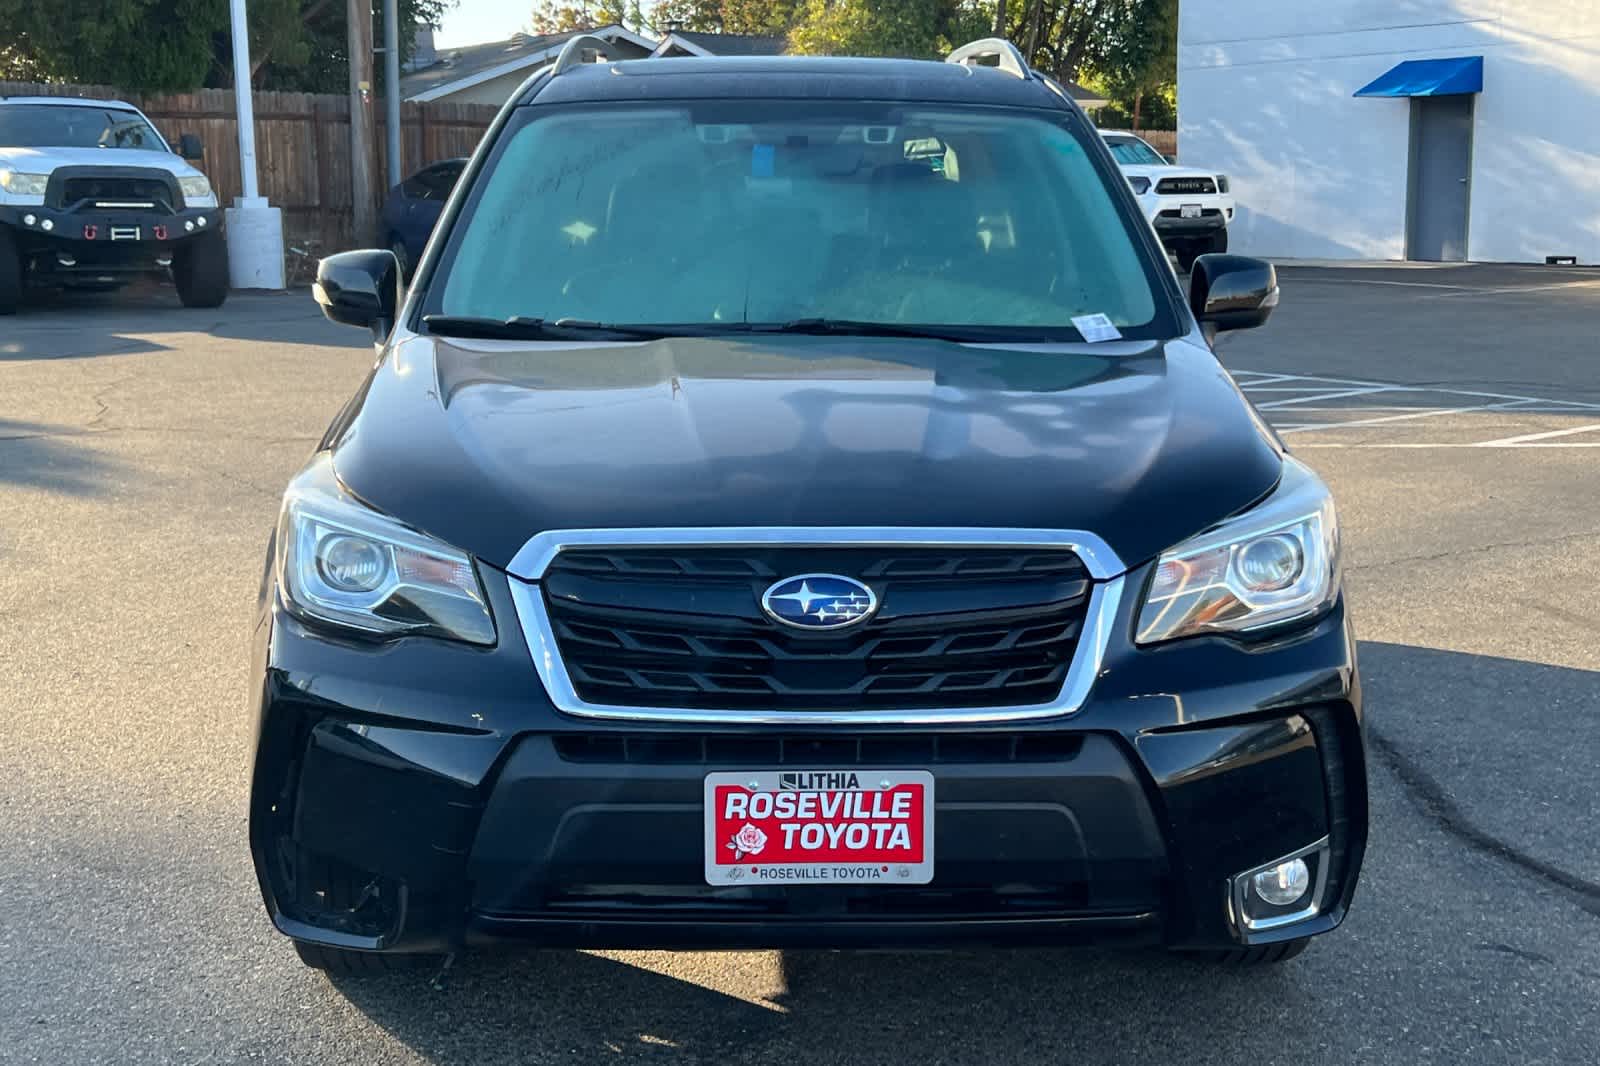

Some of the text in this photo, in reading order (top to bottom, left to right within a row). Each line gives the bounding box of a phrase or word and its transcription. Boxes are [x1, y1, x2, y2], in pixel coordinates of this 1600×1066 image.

[799, 773, 860, 789] LITHIA
[724, 792, 912, 819] ROSEVILLE
[780, 823, 911, 849] TOYOTA
[759, 867, 881, 879] ROSEVILLE TOYOTA
